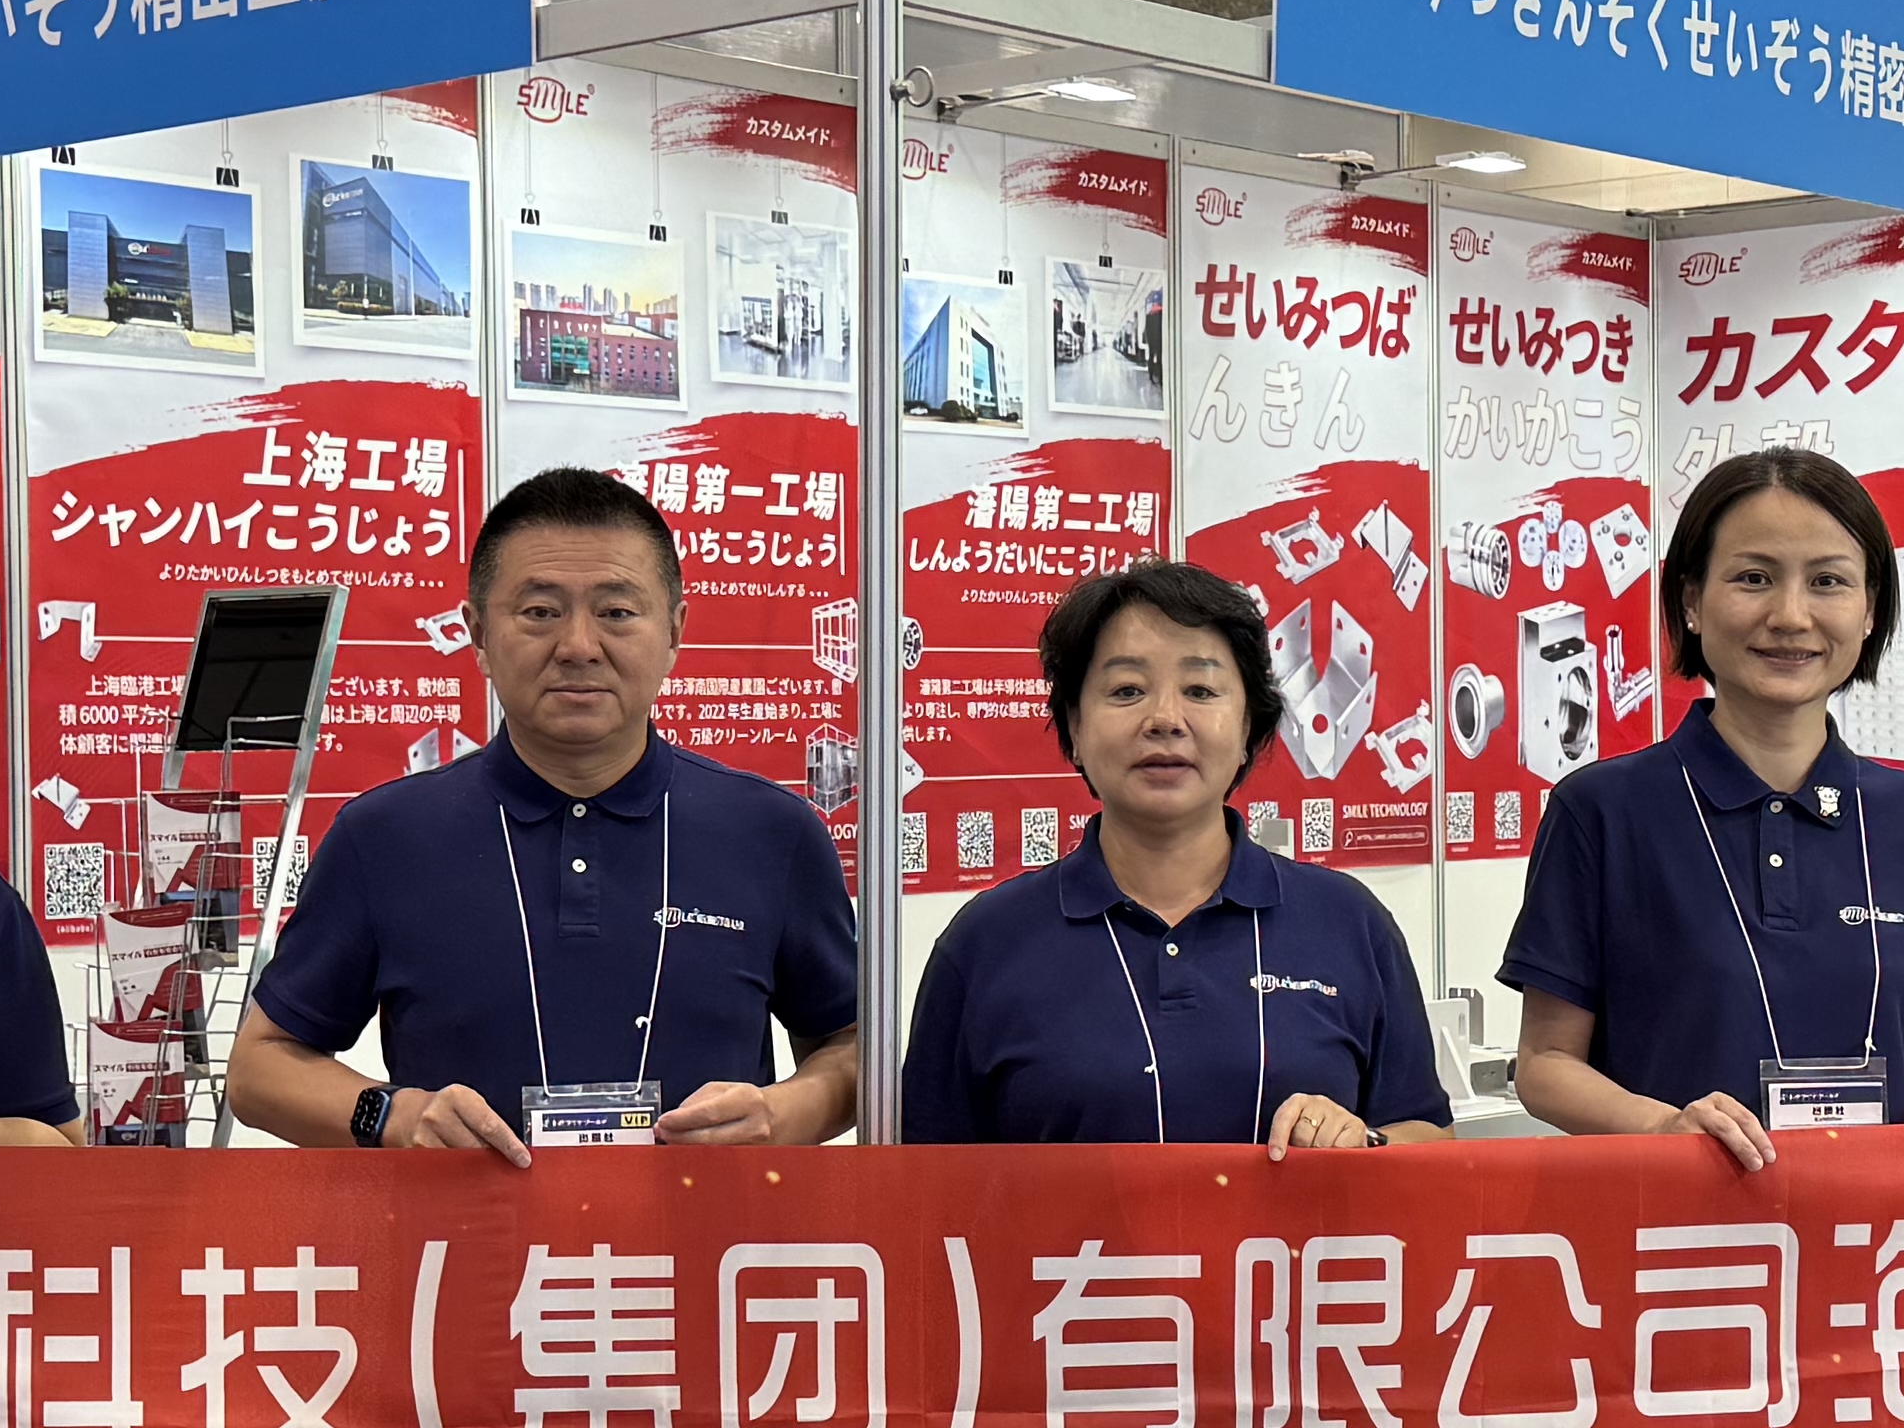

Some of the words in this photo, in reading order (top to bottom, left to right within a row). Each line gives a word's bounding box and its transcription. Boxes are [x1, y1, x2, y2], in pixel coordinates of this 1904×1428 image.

[745, 117, 829, 146] カスタムメイド
[1078, 170, 1148, 197] カスタムメイド
[1351, 214, 1410, 238] カスタムメイド
[1582, 250, 1633, 271] カスタムメイド
[1196, 263, 1417, 358] せいみつば
[1449, 297, 1634, 383] せいみつき
[1190, 354, 1365, 453] んきん
[1445, 387, 1642, 473] かいかこう
[243, 427, 447, 496] 上海工場
[51, 490, 451, 557] シャンハイこうじょう
[966, 483, 1154, 536] 瀋陽第二工場
[1343, 804, 1368, 819] SMILE
[1370, 802, 1428, 817] TECHNOLOGY
[624, 1116, 650, 1126] VIP
